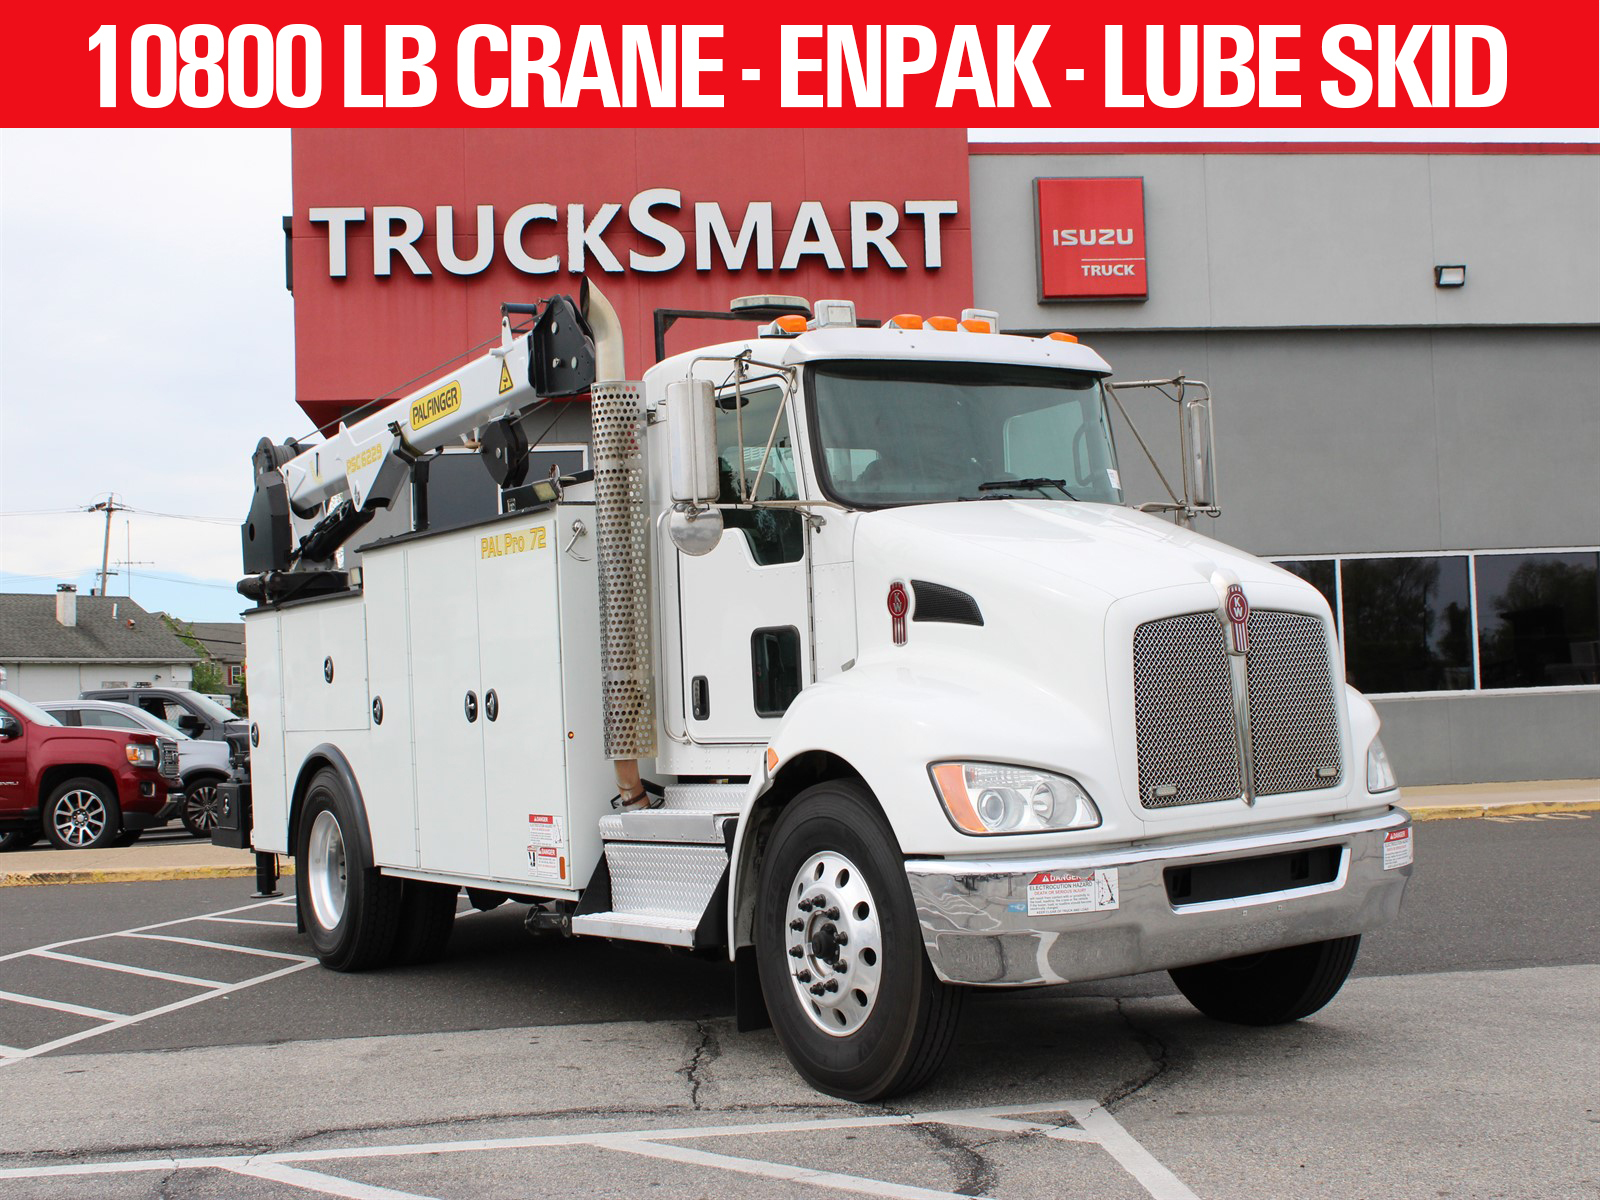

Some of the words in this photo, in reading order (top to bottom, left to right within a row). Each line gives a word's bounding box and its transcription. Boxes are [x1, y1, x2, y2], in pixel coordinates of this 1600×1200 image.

[309, 188, 959, 277] TRUCKSMART
[1053, 229, 1134, 246] ISUZU
[1081, 264, 1136, 276] TRUCK
[412, 387, 459, 425] PALFINGER
[481, 535, 502, 559] PAL
[504, 533, 525, 555] Pro
[530, 526, 547, 551] 72
[1029, 883, 1072, 891] ELECTROCUTION
